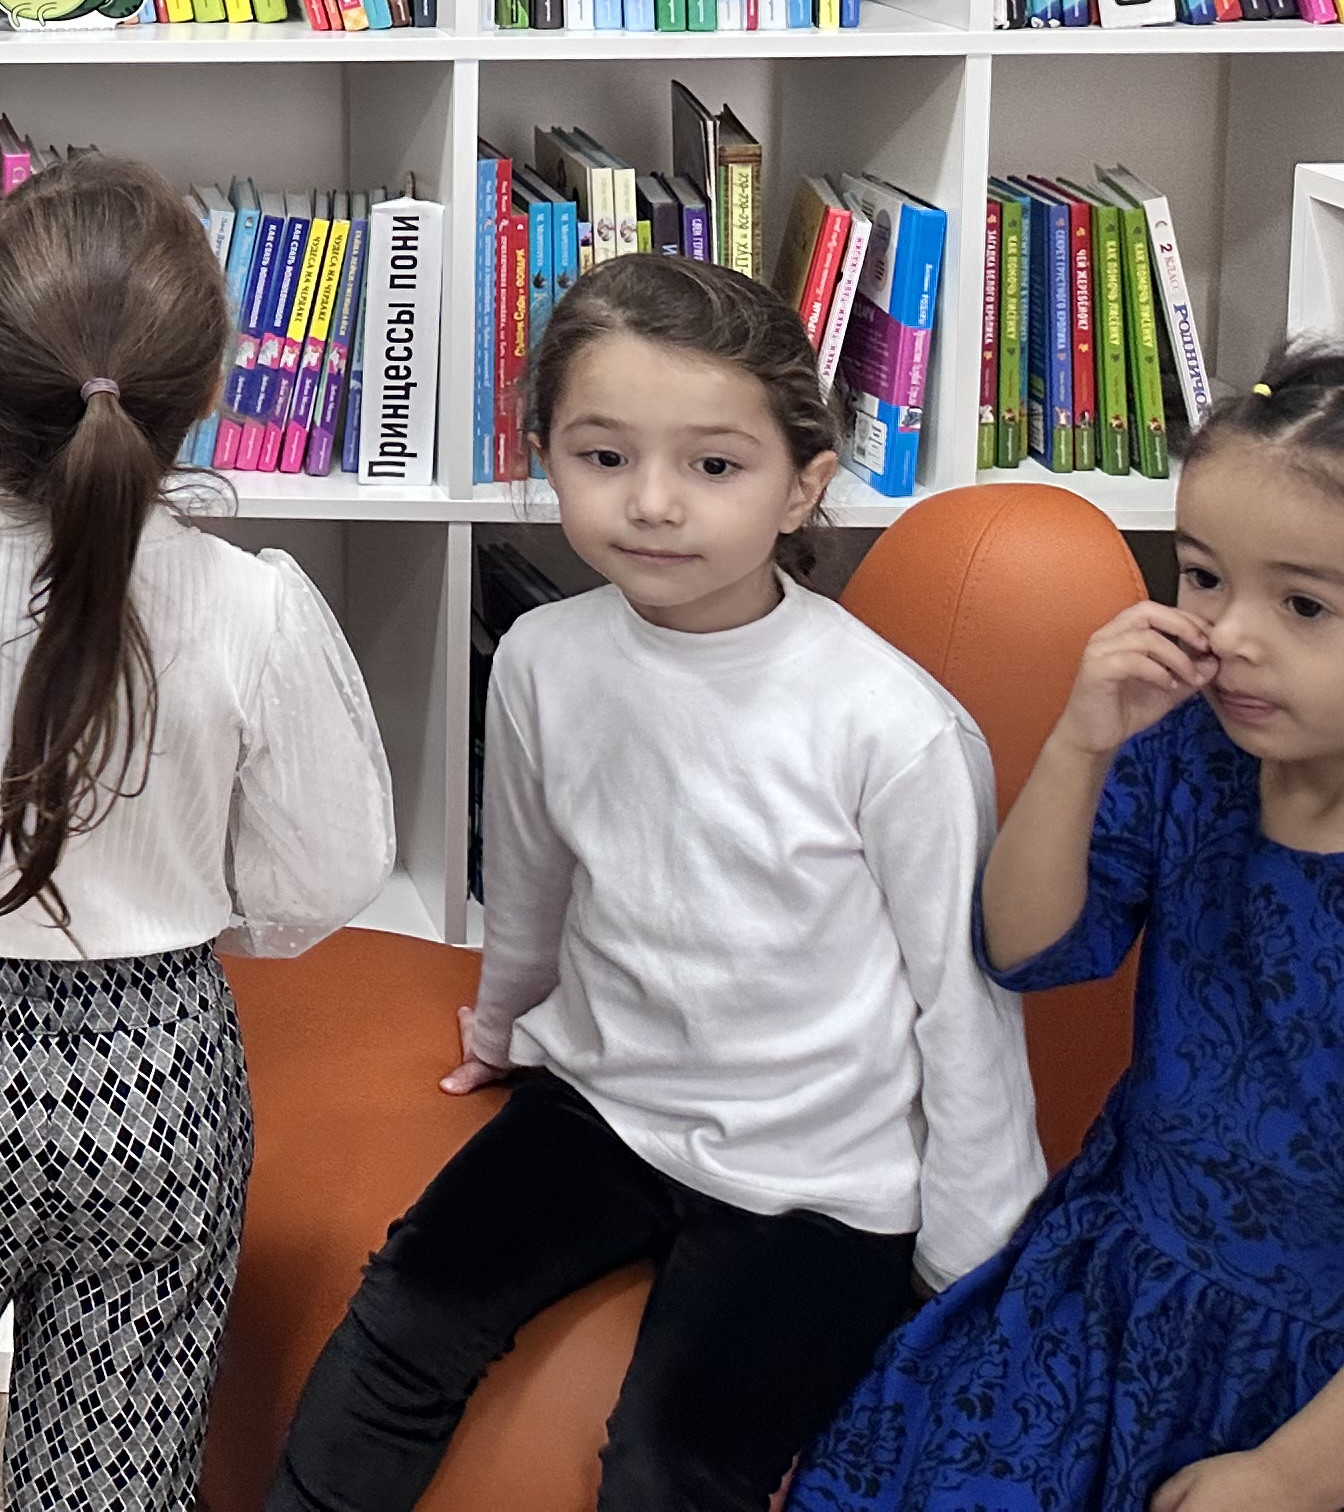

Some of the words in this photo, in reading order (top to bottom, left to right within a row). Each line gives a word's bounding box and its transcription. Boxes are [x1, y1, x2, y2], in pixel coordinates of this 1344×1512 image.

[326, 235, 343, 267] ЧУДЕСА
[390, 215, 420, 289] пони
[1160, 244, 1174, 253] 2
[324, 270, 335, 281] НА
[316, 284, 333, 321] ЧЕРДАКЕ
[369, 303, 417, 478] Принцессы
